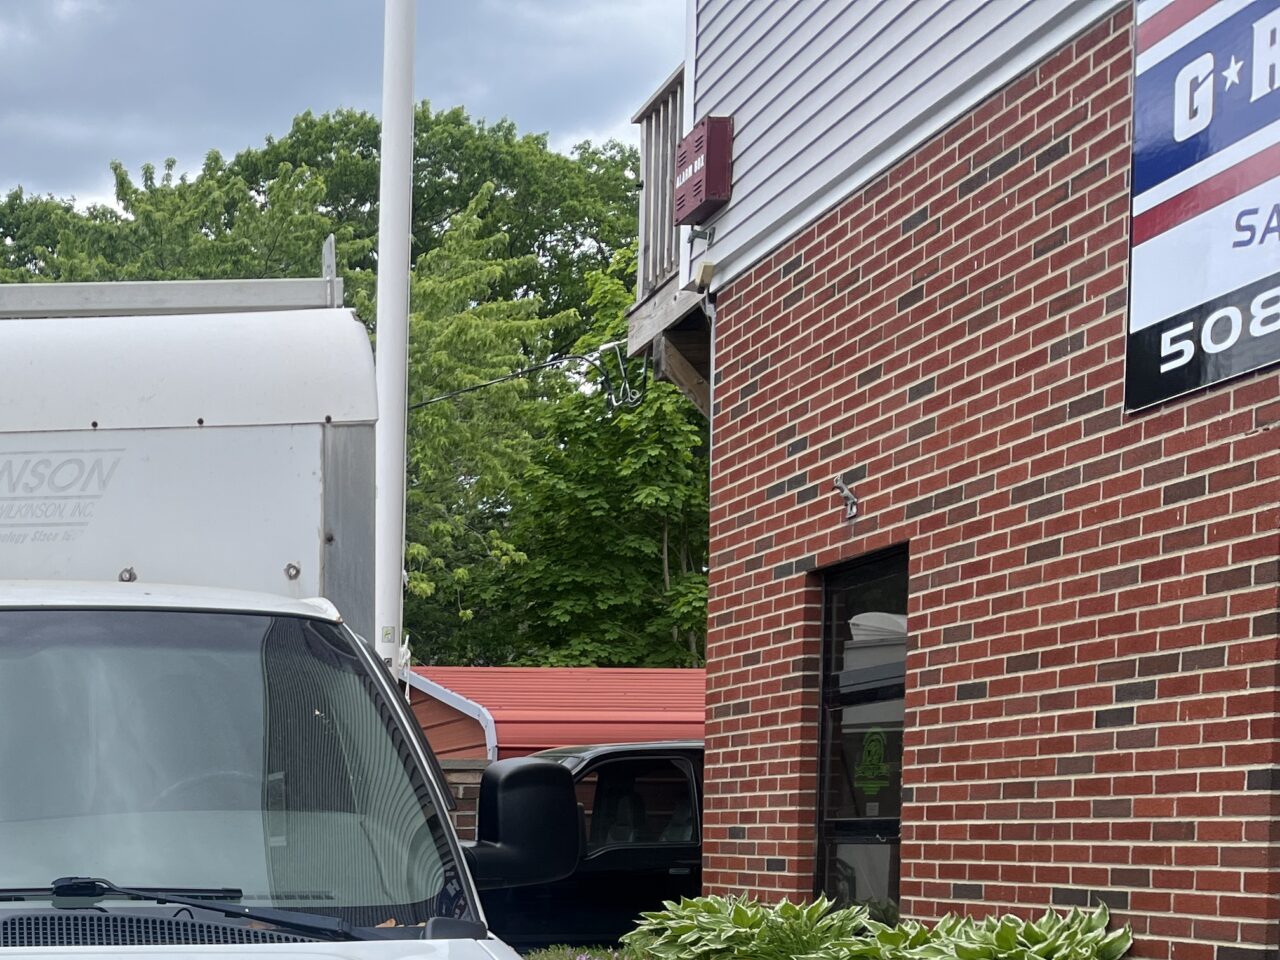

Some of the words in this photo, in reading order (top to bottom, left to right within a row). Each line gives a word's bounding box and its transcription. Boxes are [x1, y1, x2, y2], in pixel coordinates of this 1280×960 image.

[676, 163, 693, 189] ALARM
[694, 154, 705, 173] BOX
[1160, 286, 1280, 373] 508
[69, 502, 95, 518] INC.
[30, 530, 59, 543] Since
